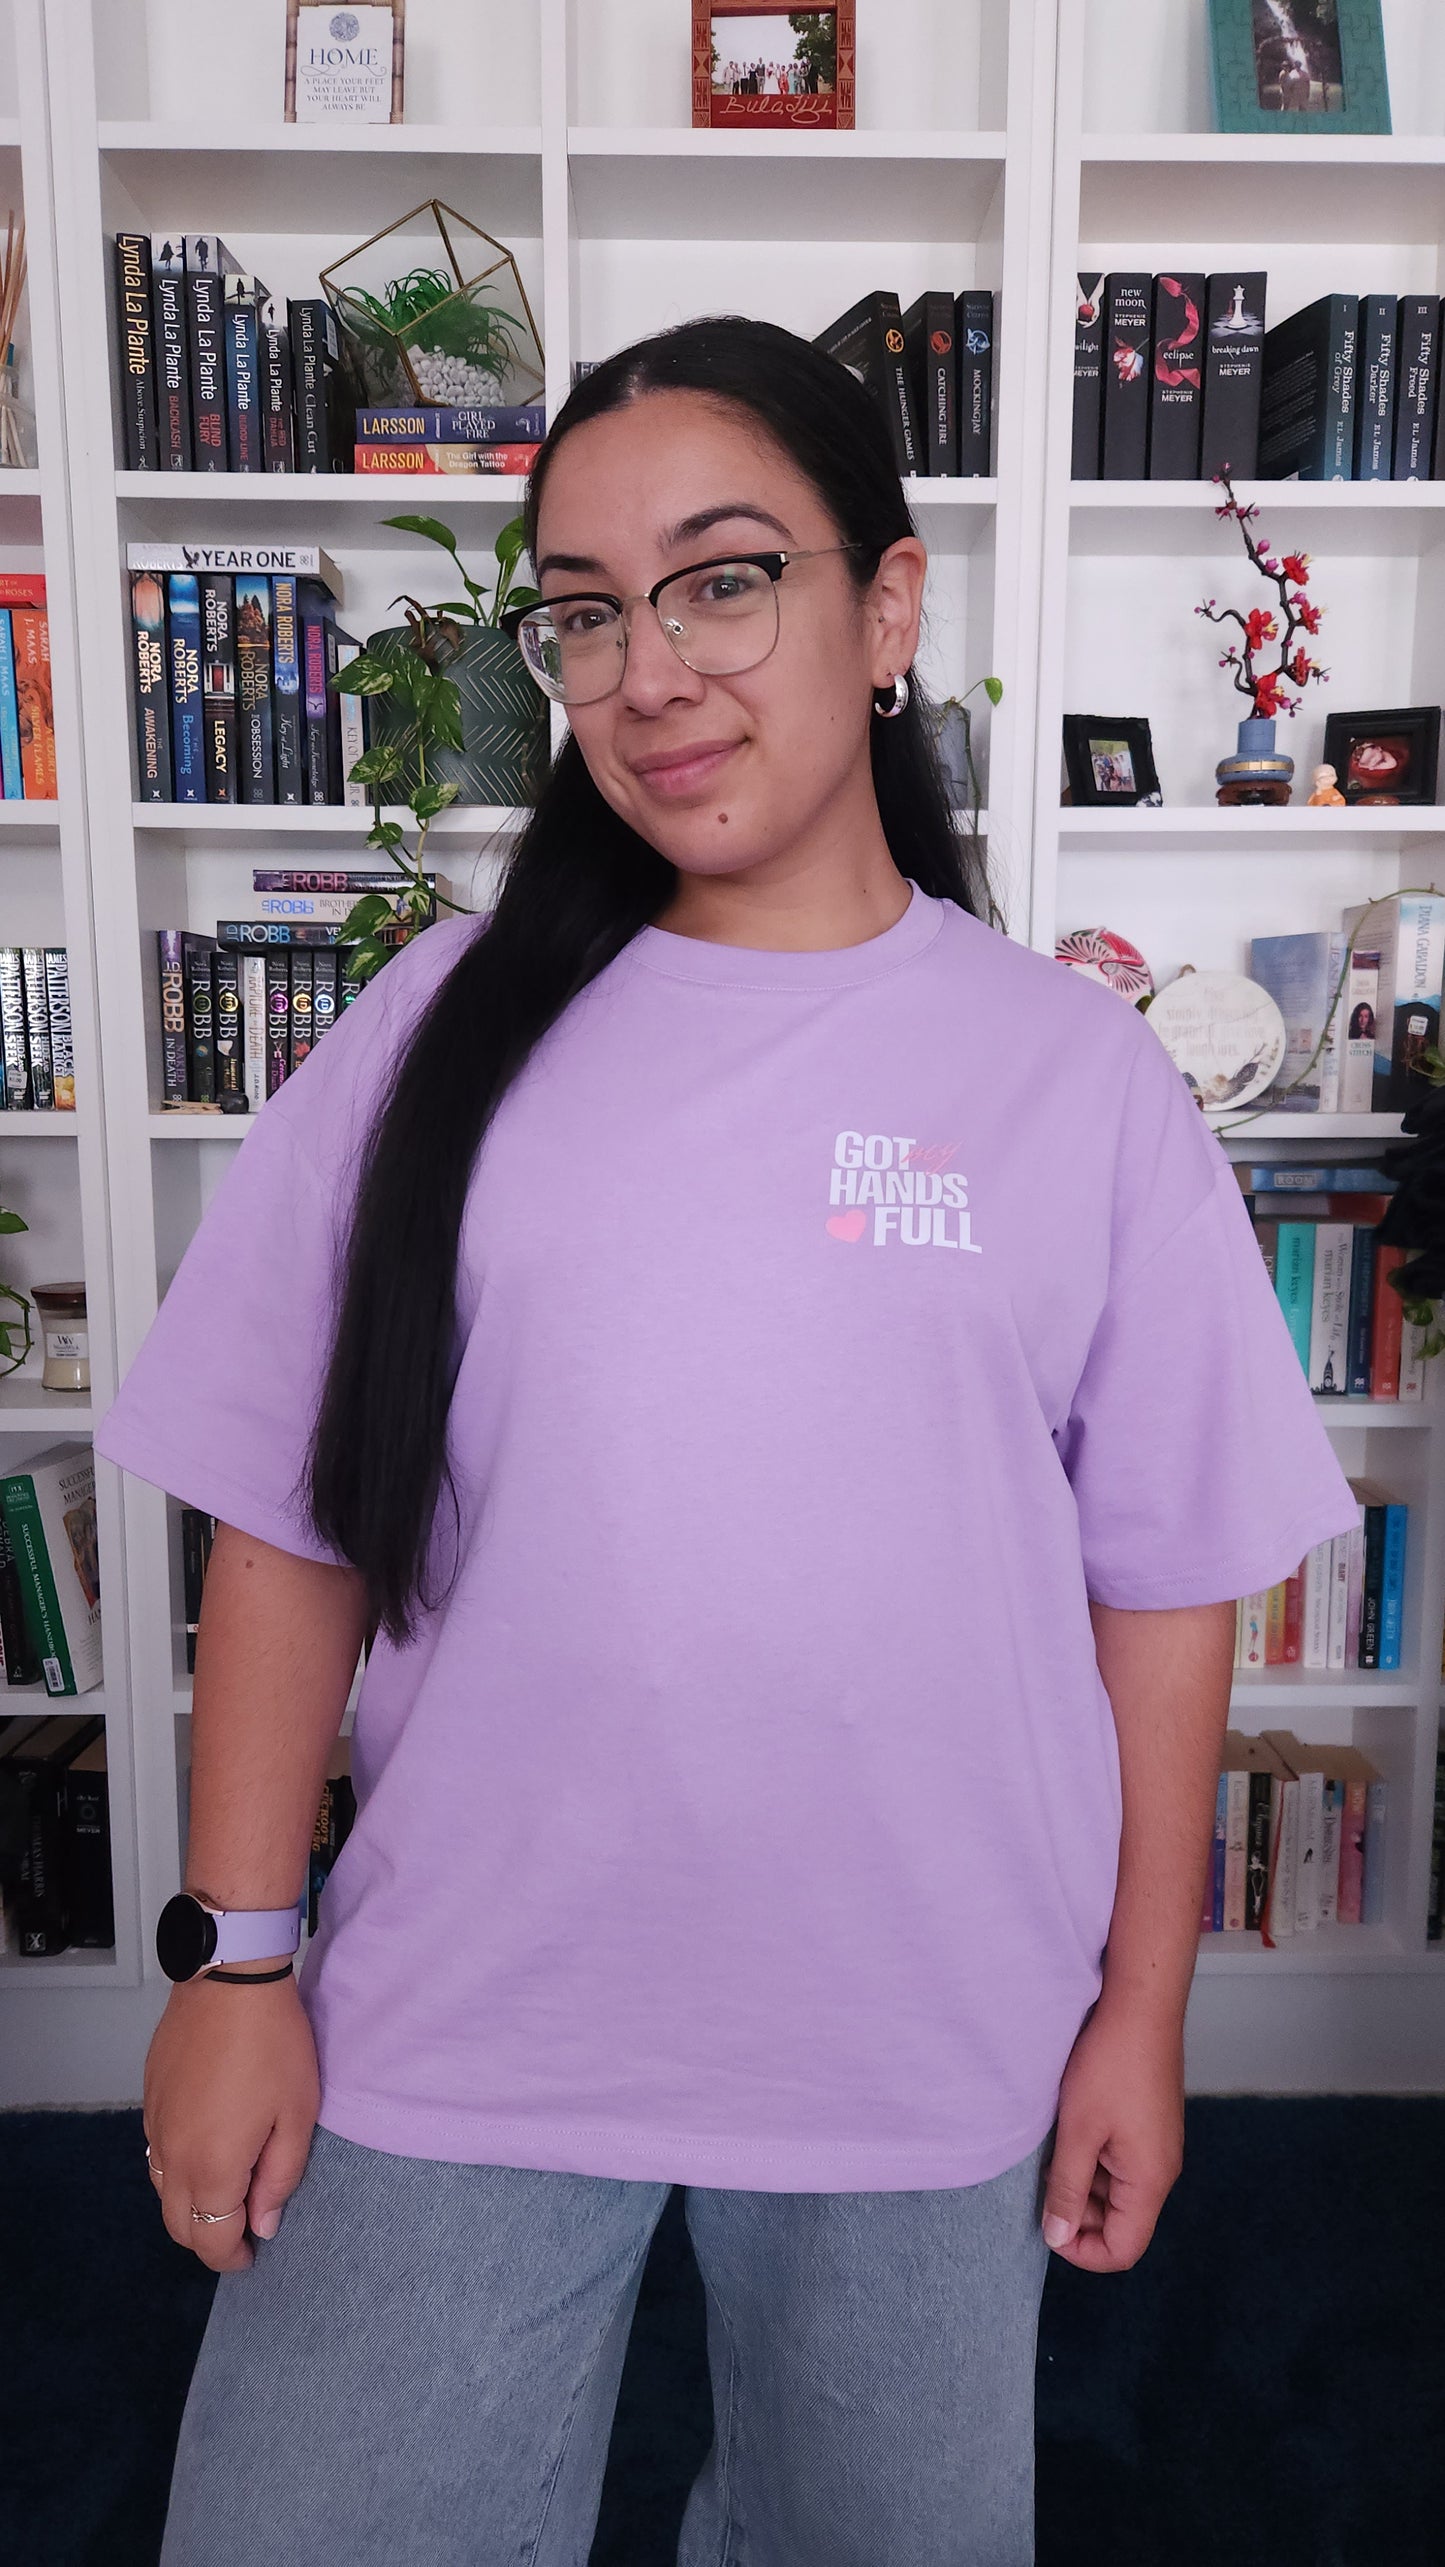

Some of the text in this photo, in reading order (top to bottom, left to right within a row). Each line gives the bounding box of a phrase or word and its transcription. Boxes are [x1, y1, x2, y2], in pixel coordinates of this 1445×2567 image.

[310, 47, 378, 66] HOME
[313, 86, 375, 94] MAY LEAVE BUT
[119, 236, 150, 375] Lynda La Plante
[1114, 298, 1147, 310] moon
[1120, 288, 1142, 297] new
[159, 279, 182, 389] Lynda La Plante
[193, 279, 218, 400] Lynda La Plante
[1114, 319, 1146, 327] MEYER
[232, 313, 251, 410] Lynda La Plante
[301, 307, 316, 390] Lynda La Plante
[1163, 350, 1194, 368] eclipse
[1211, 344, 1259, 360] breaking dawn
[266, 329, 283, 412] Lynda La Plante
[1219, 368, 1251, 376] MEYER
[1332, 352, 1343, 394] of Grey
[1341, 330, 1354, 414] Fifty Shades
[1369, 364, 1380, 404] Darker
[1378, 333, 1391, 417] Fifty Shades
[1408, 366, 1418, 398] Freed
[1417, 332, 1432, 415] Fifty Shades
[135, 379, 146, 450] Above Suspicion
[458, 411, 484, 420] GIRL
[895, 367, 915, 461] THE HUNGER GAMES
[936, 367, 947, 445] CATCHING FIRE
[971, 368, 981, 436] MOCKINGJAY
[1161, 394, 1193, 402] MEYER
[169, 395, 181, 448] BACKLASH
[198, 416, 211, 445] FURY
[209, 413, 221, 447] BLIND
[239, 414, 249, 460] BLOOD LINE
[269, 417, 279, 447] DAHLIA
[278, 429, 286, 447] RED
[305, 393, 317, 454] Clean Cut
[362, 417, 425, 434] LARSSON
[452, 421, 496, 430] PLAYED
[466, 430, 490, 440] FIRE
[362, 452, 424, 469] LARSSON
[446, 452, 508, 460] The Girl with the
[449, 460, 505, 469] Dragon Tattoo
[1335, 435, 1344, 467] James
[1372, 438, 1381, 470] James
[1410, 436, 1419, 469] James
[202, 550, 296, 568] YEAR ONE
[6, 588, 34, 596] ROSES
[204, 588, 217, 652] ROBERTS
[217, 601, 229, 640] NORA
[275, 583, 294, 664] NORA ROBERTS
[25, 629, 37, 664] MAAS
[38, 620, 50, 662] SARAH
[306, 625, 323, 693] NORA ROBERTS
[1, 665, 10, 697] MAAS
[137, 631, 152, 694] ROBERTS
[149, 641, 162, 683] NORA
[173, 638, 188, 704] ROBERTS
[186, 649, 200, 694] NORA
[240, 650, 256, 711] ROBERTS
[254, 663, 268, 700] NORA
[144, 707, 158, 779] AWAKENING
[180, 714, 194, 775] Becoming
[214, 720, 227, 774] LEGACY
[250, 718, 263, 779] OBSESSION
[279, 713, 294, 769] Key Light
[347, 727, 359, 744] KEY
[292, 872, 347, 892] ROBB
[270, 899, 315, 914] ROBB
[331, 906, 342, 916] IN
[240, 924, 291, 943] ROBB
[1415, 905, 1432, 989] DIANA GABALDON
[46, 952, 67, 964] JAMES
[166, 961, 182, 973] J.D.
[0, 963, 25, 1033] PATTERSON
[25, 963, 49, 1033] PATTERSON
[47, 962, 72, 1035] PATTERSON
[162, 972, 185, 1033] ROBB
[192, 979, 212, 1039] ROBB
[218, 979, 239, 1039] ROBB
[248, 975, 264, 1018] RAPTURE
[269, 979, 289, 1039] ROBB
[292, 979, 312, 1039] ROBB
[5, 1034, 18, 1067] SEEK
[17, 1035, 25, 1057] HIDE
[30, 1034, 44, 1068] SEEK
[41, 1035, 49, 1059] HIDE
[51, 1034, 65, 1077] MARKET
[62, 1034, 75, 1078] BLACK
[165, 1037, 177, 1087] IN DEATH
[249, 1025, 265, 1060] DEATH
[1349, 1049, 1373, 1057] STITCH
[176, 1045, 185, 1083] NAKED
[834, 1130, 917, 1171] GOT
[829, 1168, 969, 1209] HANDS
[1276, 1174, 1315, 1185] ROOM
[873, 1206, 982, 1254] FULL
[1291, 1237, 1301, 1275] marian
[1288, 1277, 1301, 1305] keyes
[1320, 1249, 1336, 1323] marian keyes
[21, 1523, 47, 1619] SUCCESSFUL MANAGER'S
[1365, 1597, 1376, 1651] JOHN GREEN
